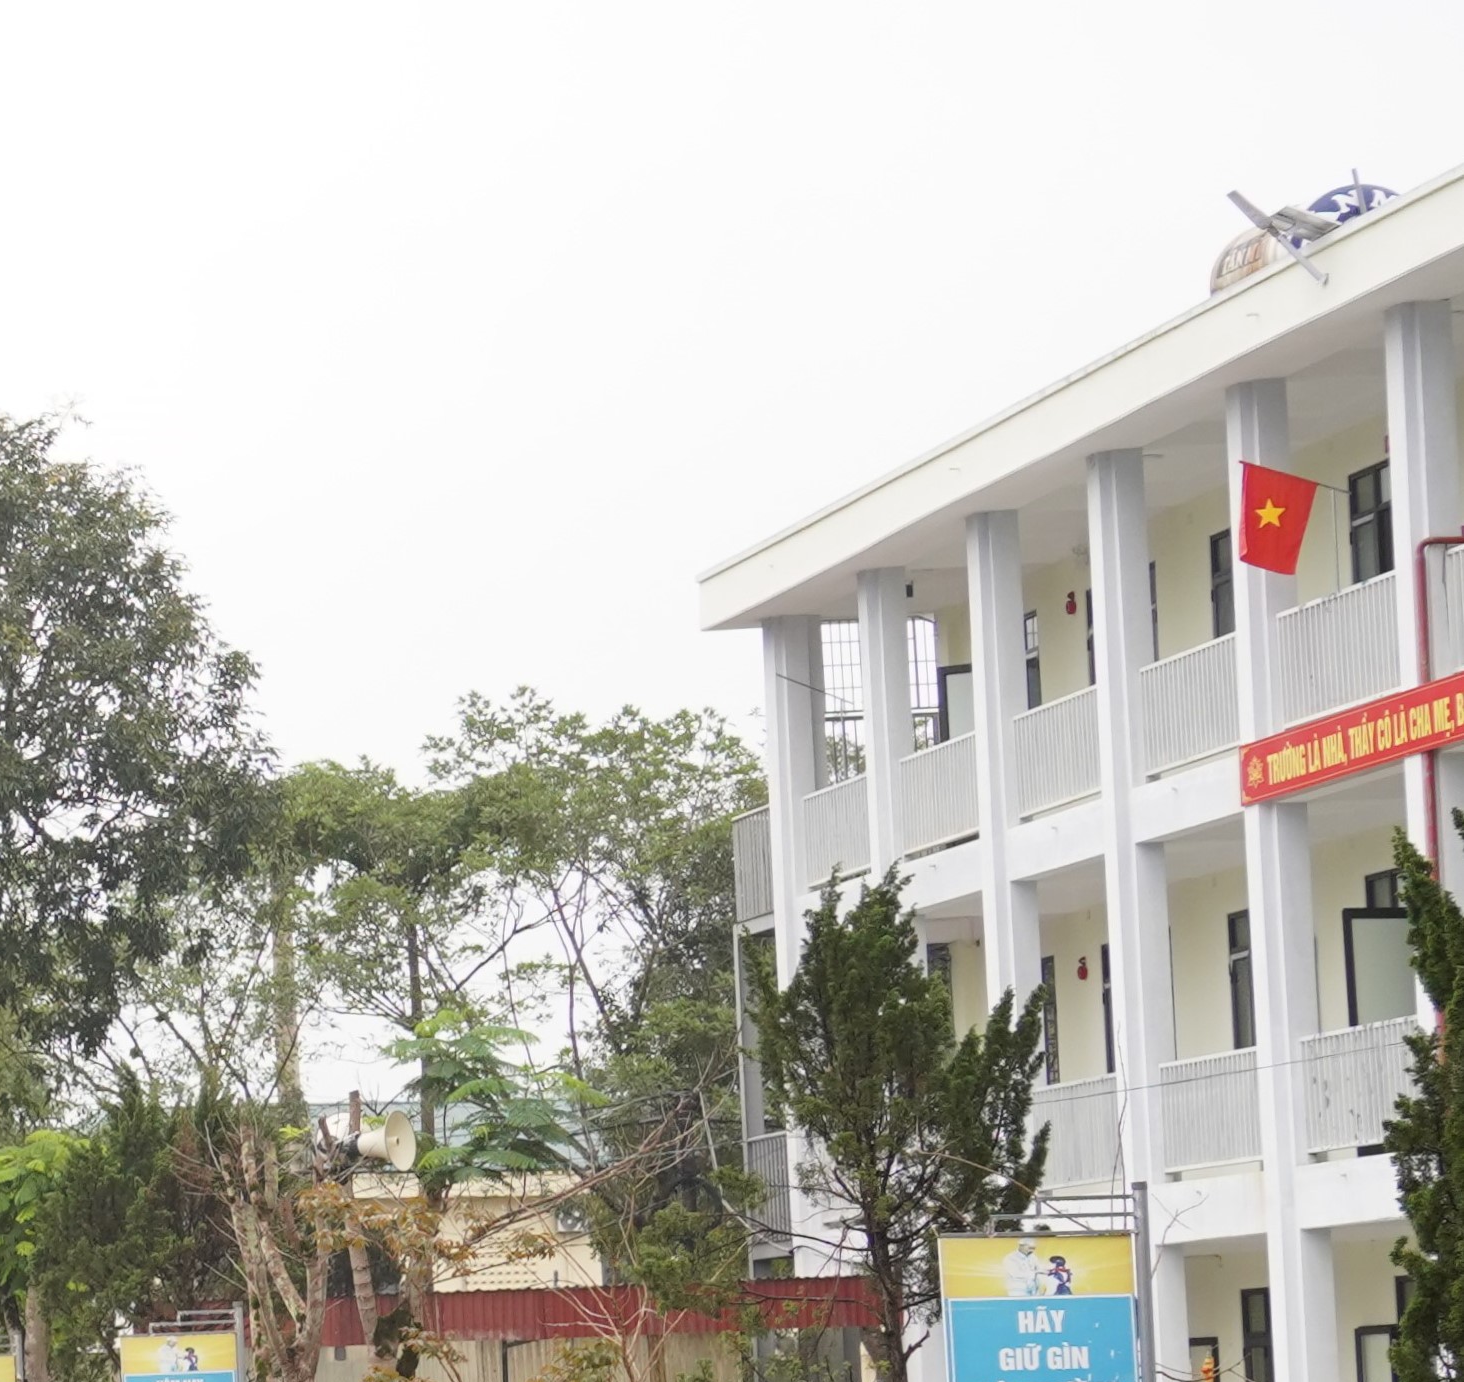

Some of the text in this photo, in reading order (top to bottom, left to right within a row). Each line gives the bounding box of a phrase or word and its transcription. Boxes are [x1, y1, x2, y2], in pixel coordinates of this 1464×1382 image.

[1266, 741, 1307, 785] TRƯỜNG
[1307, 733, 1322, 773] LÀ
[1322, 725, 1348, 766] NHÀ,
[1348, 712, 1375, 760] THẦY
[1377, 709, 1393, 751] CÔ
[1393, 704, 1409, 746] LÀ
[1409, 703, 1433, 741] CHA
[1433, 696, 1455, 738] MẸ,
[1017, 1305, 1066, 1334] HÃY
[998, 1341, 1090, 1371] GIỮ GÌN
